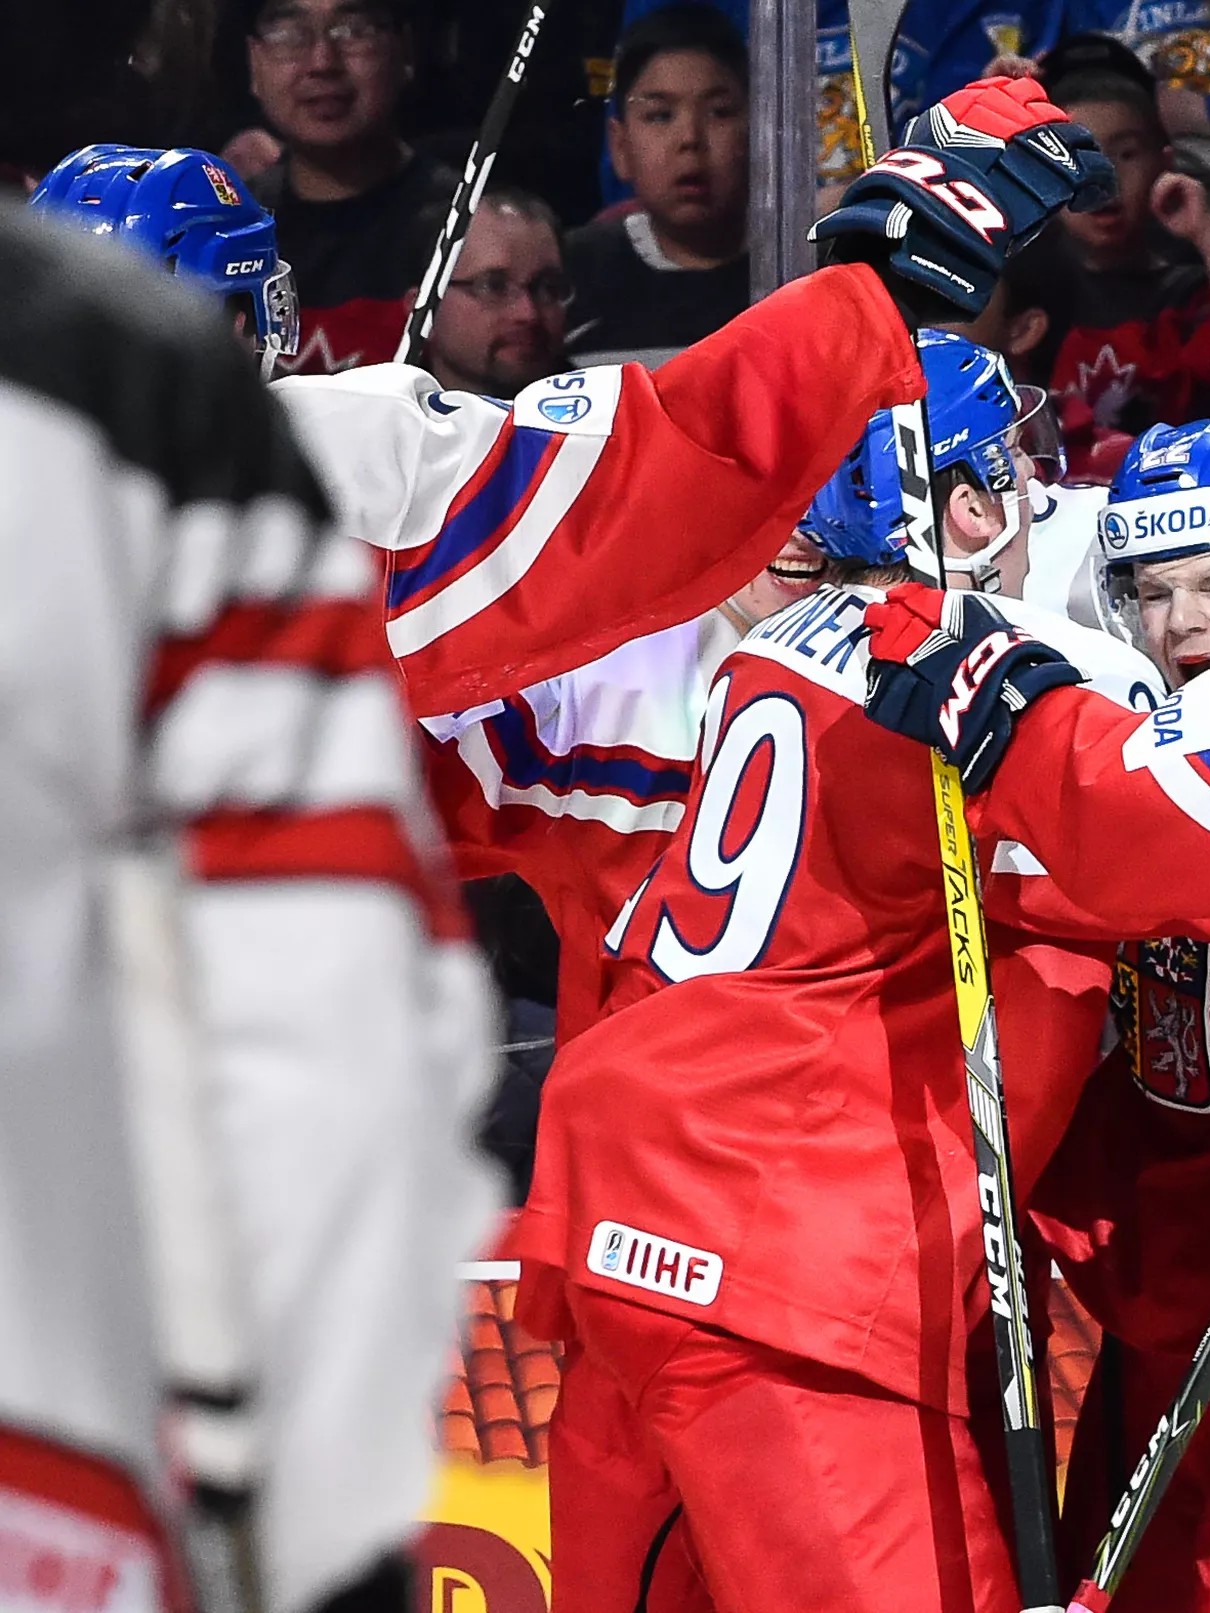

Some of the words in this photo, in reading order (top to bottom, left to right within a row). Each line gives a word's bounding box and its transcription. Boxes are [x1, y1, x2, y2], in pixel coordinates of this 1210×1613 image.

[507, 5, 545, 83] CCM
[862, 148, 1009, 246] CC
[225, 258, 264, 276] CCM
[929, 427, 970, 456] CM
[893, 399, 941, 588] CM
[937, 624, 1034, 751] CM
[1153, 689, 1185, 748] ODA
[938, 772, 959, 858] SUPER
[942, 857, 978, 988] TACKS
[626, 1237, 709, 1293] IIHF
[978, 1172, 1014, 1320] CCM
[1110, 1414, 1170, 1529] CCM
